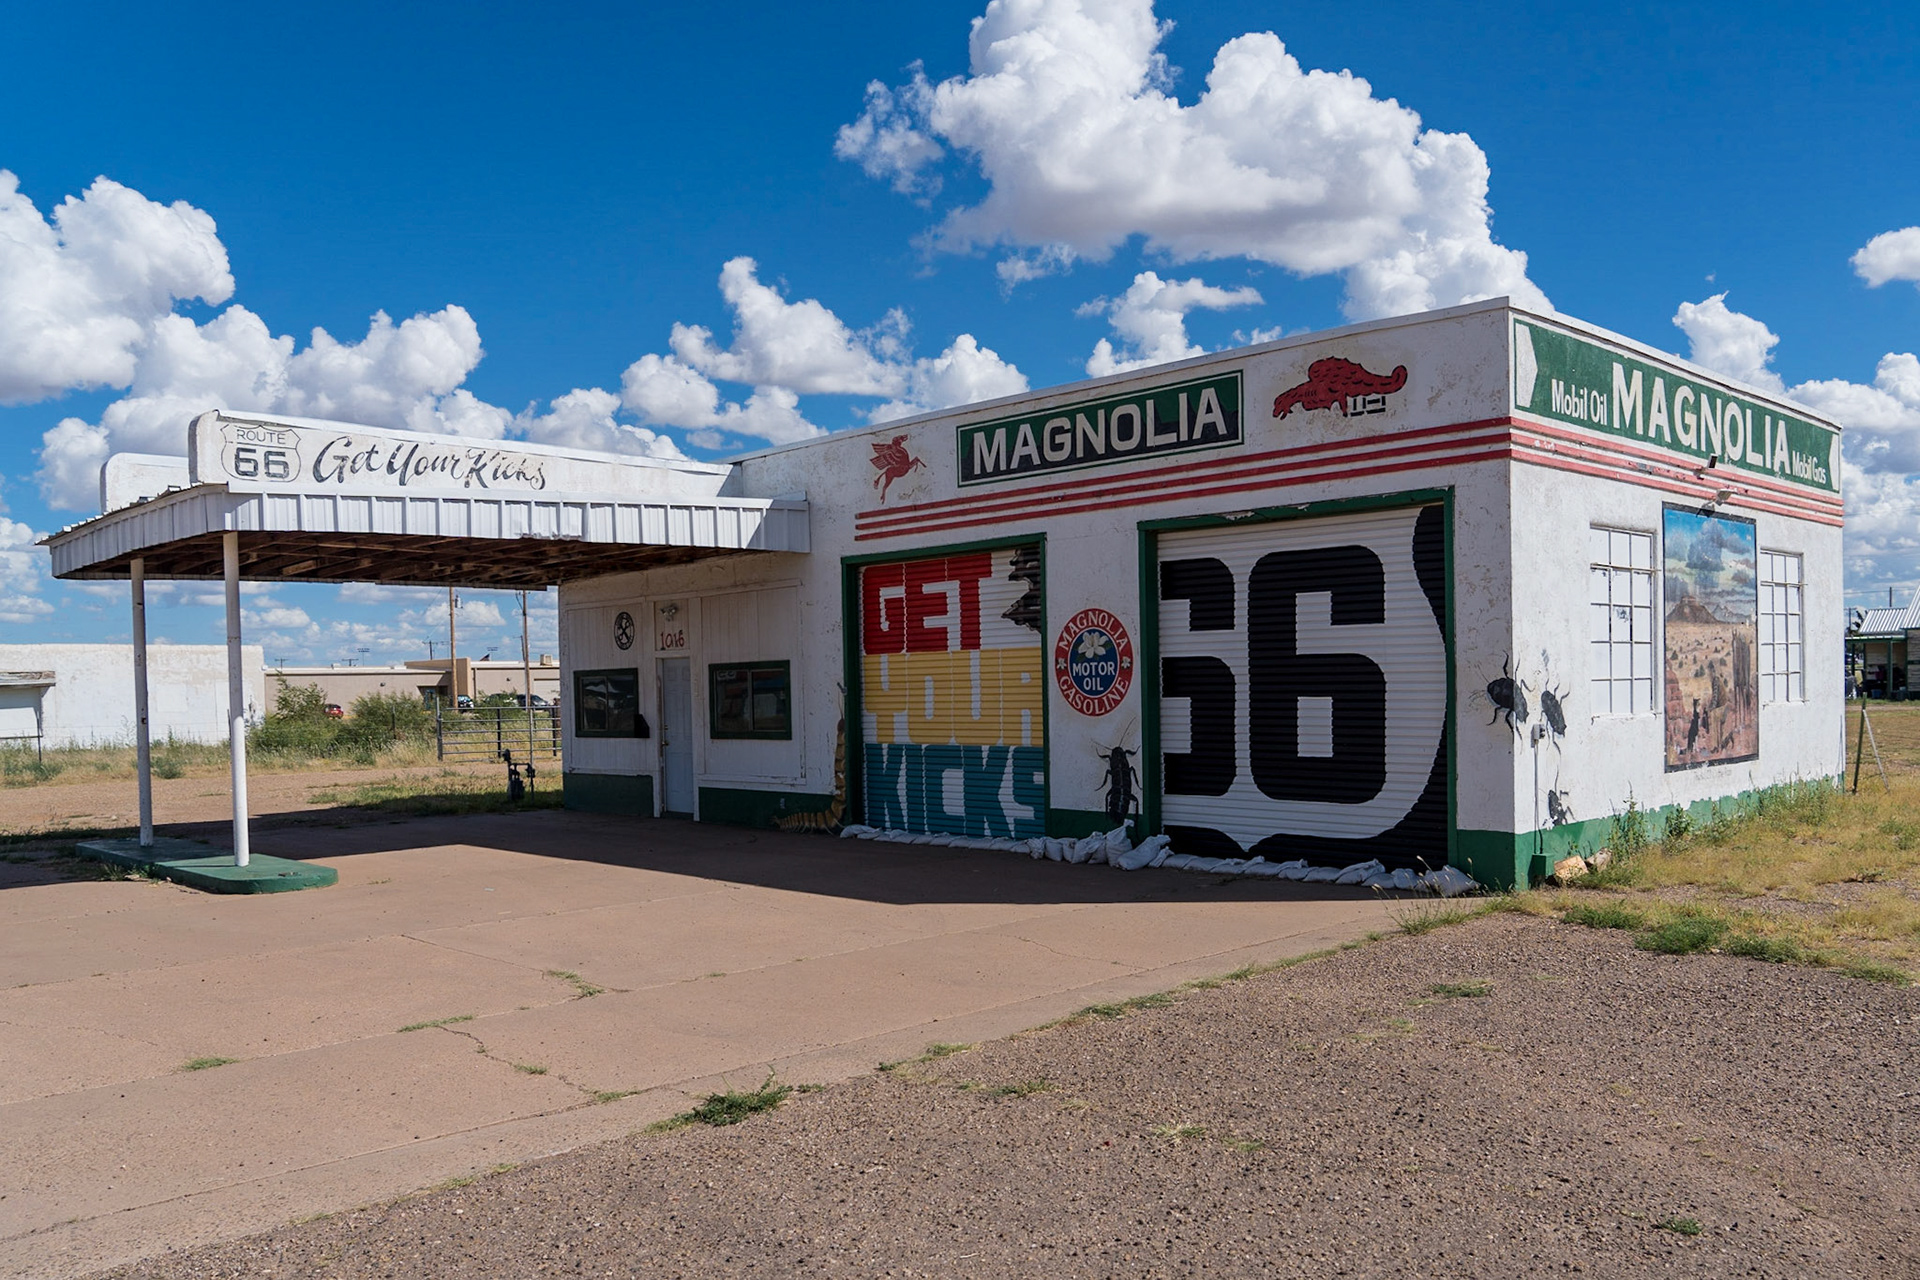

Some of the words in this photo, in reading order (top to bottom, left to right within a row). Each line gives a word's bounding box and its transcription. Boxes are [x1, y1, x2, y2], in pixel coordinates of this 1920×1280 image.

[236, 428, 287, 445] ROUTE
[973, 388, 1227, 475] MAGNOLIA
[1551, 378, 1588, 421] Mobil
[1590, 390, 1607, 426] Oil
[1612, 361, 1791, 474] MAGNOLIA
[1792, 450, 1813, 480] Mobil
[1813, 456, 1826, 485] Gas
[234, 447, 290, 479] 66
[312, 435, 384, 484] Get
[385, 443, 464, 487] Your
[463, 448, 546, 491] Kicks
[863, 552, 992, 656] GET
[1058, 611, 1128, 651] MAGNOLIA
[1072, 661, 1116, 677] MOTOR
[1083, 677, 1104, 691] OIL
[864, 647, 1043, 746] YOUR
[1060, 676, 1129, 715] GASOLINE
[865, 743, 1044, 840] KICKS
